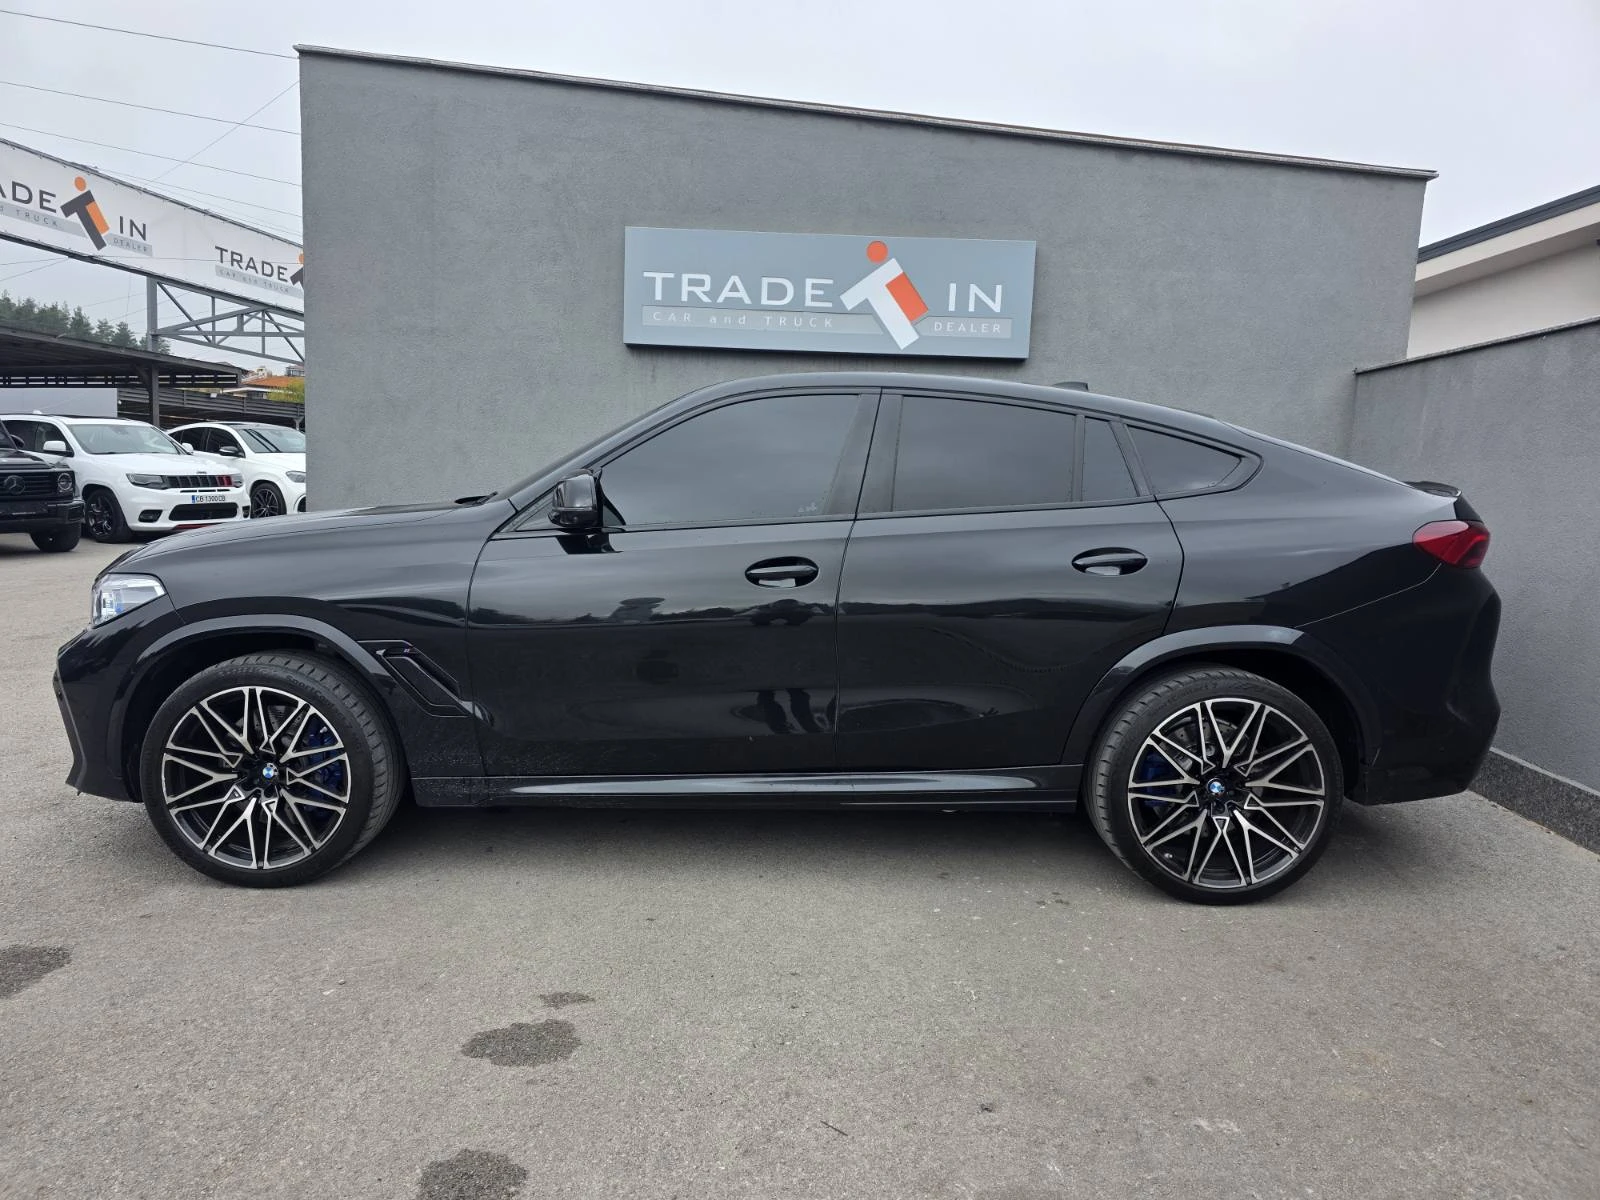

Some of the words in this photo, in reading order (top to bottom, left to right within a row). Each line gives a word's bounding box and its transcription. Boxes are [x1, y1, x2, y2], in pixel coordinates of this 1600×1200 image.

[119, 216, 147, 241] IN
[215, 245, 288, 282] TRADE
[643, 271, 834, 308] TRADE
[947, 283, 1002, 313] IN
[653, 311, 693, 323] CAR
[709, 314, 747, 326] and
[764, 316, 835, 329] TRUCK
[933, 321, 1002, 334] DEALER
